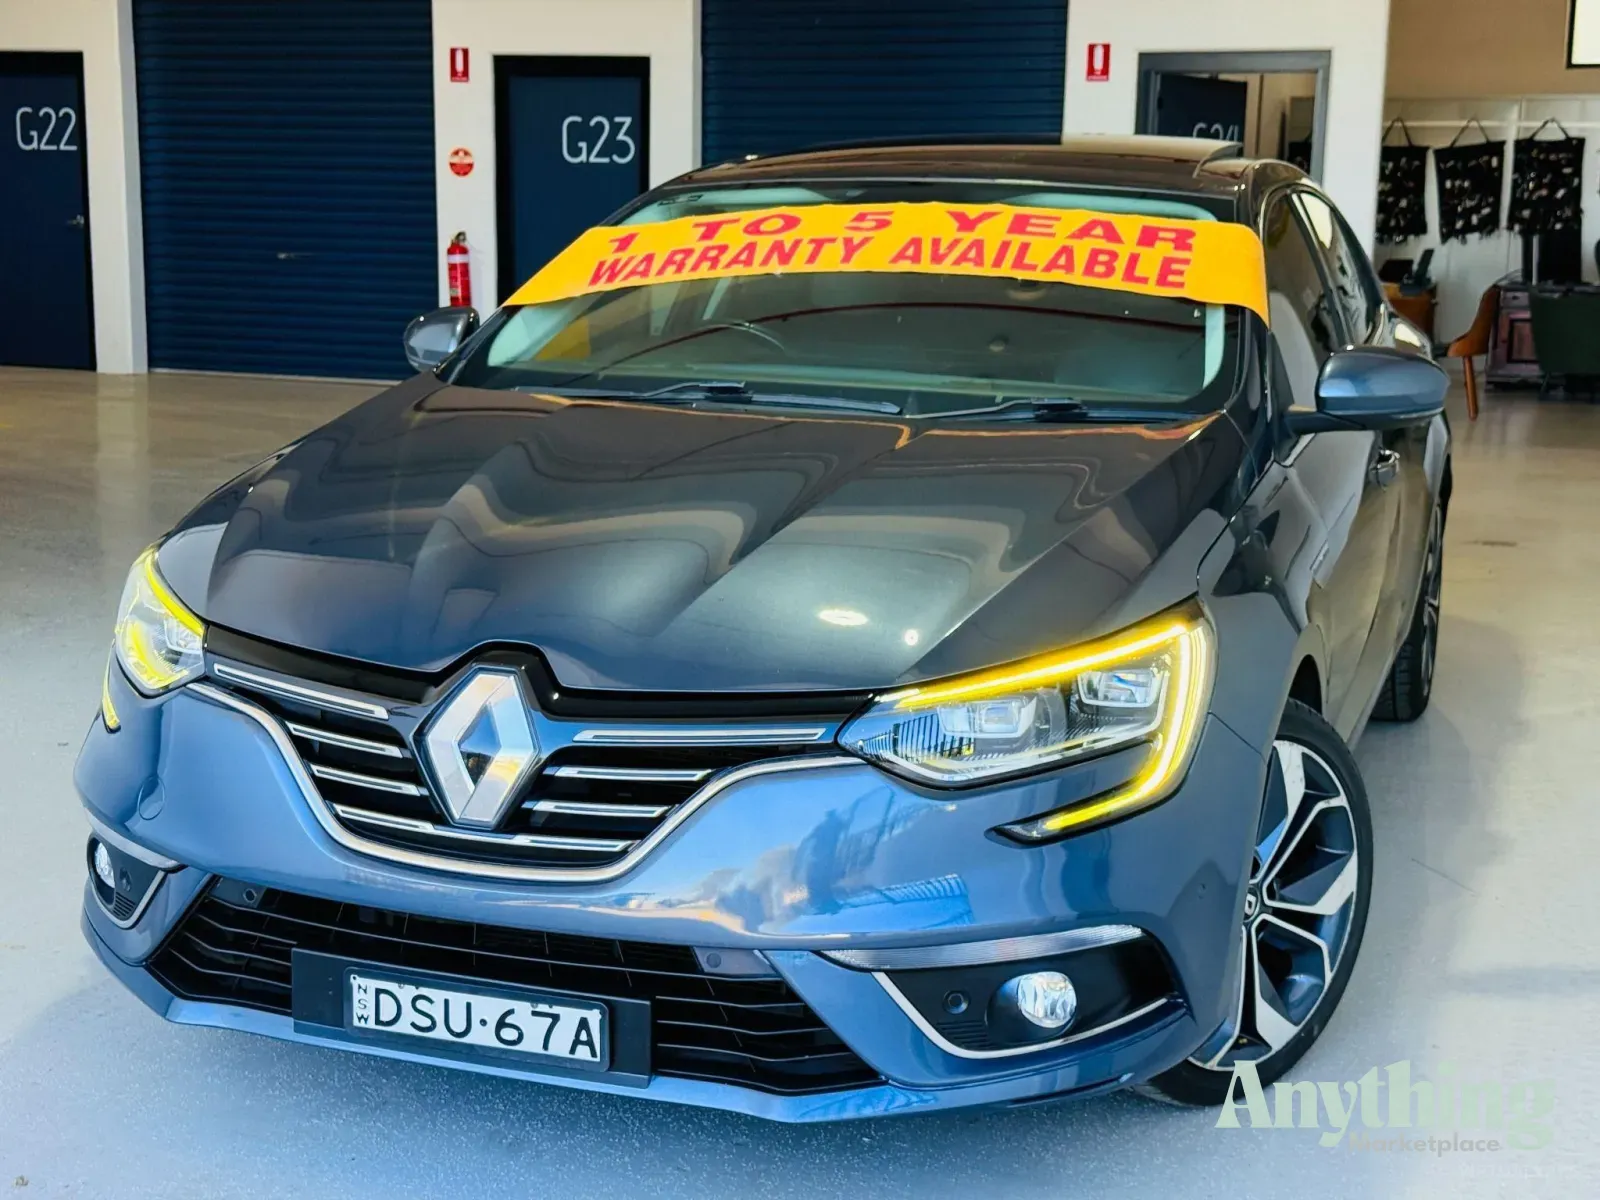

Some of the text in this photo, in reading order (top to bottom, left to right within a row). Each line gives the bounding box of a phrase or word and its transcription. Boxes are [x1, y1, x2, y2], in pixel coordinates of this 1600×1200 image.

[15, 106, 78, 151] G22
[562, 115, 636, 164] G23
[609, 210, 1197, 254] 1 TO 5 YEAR
[588, 236, 1192, 289] WARRANTY AVAILABLE
